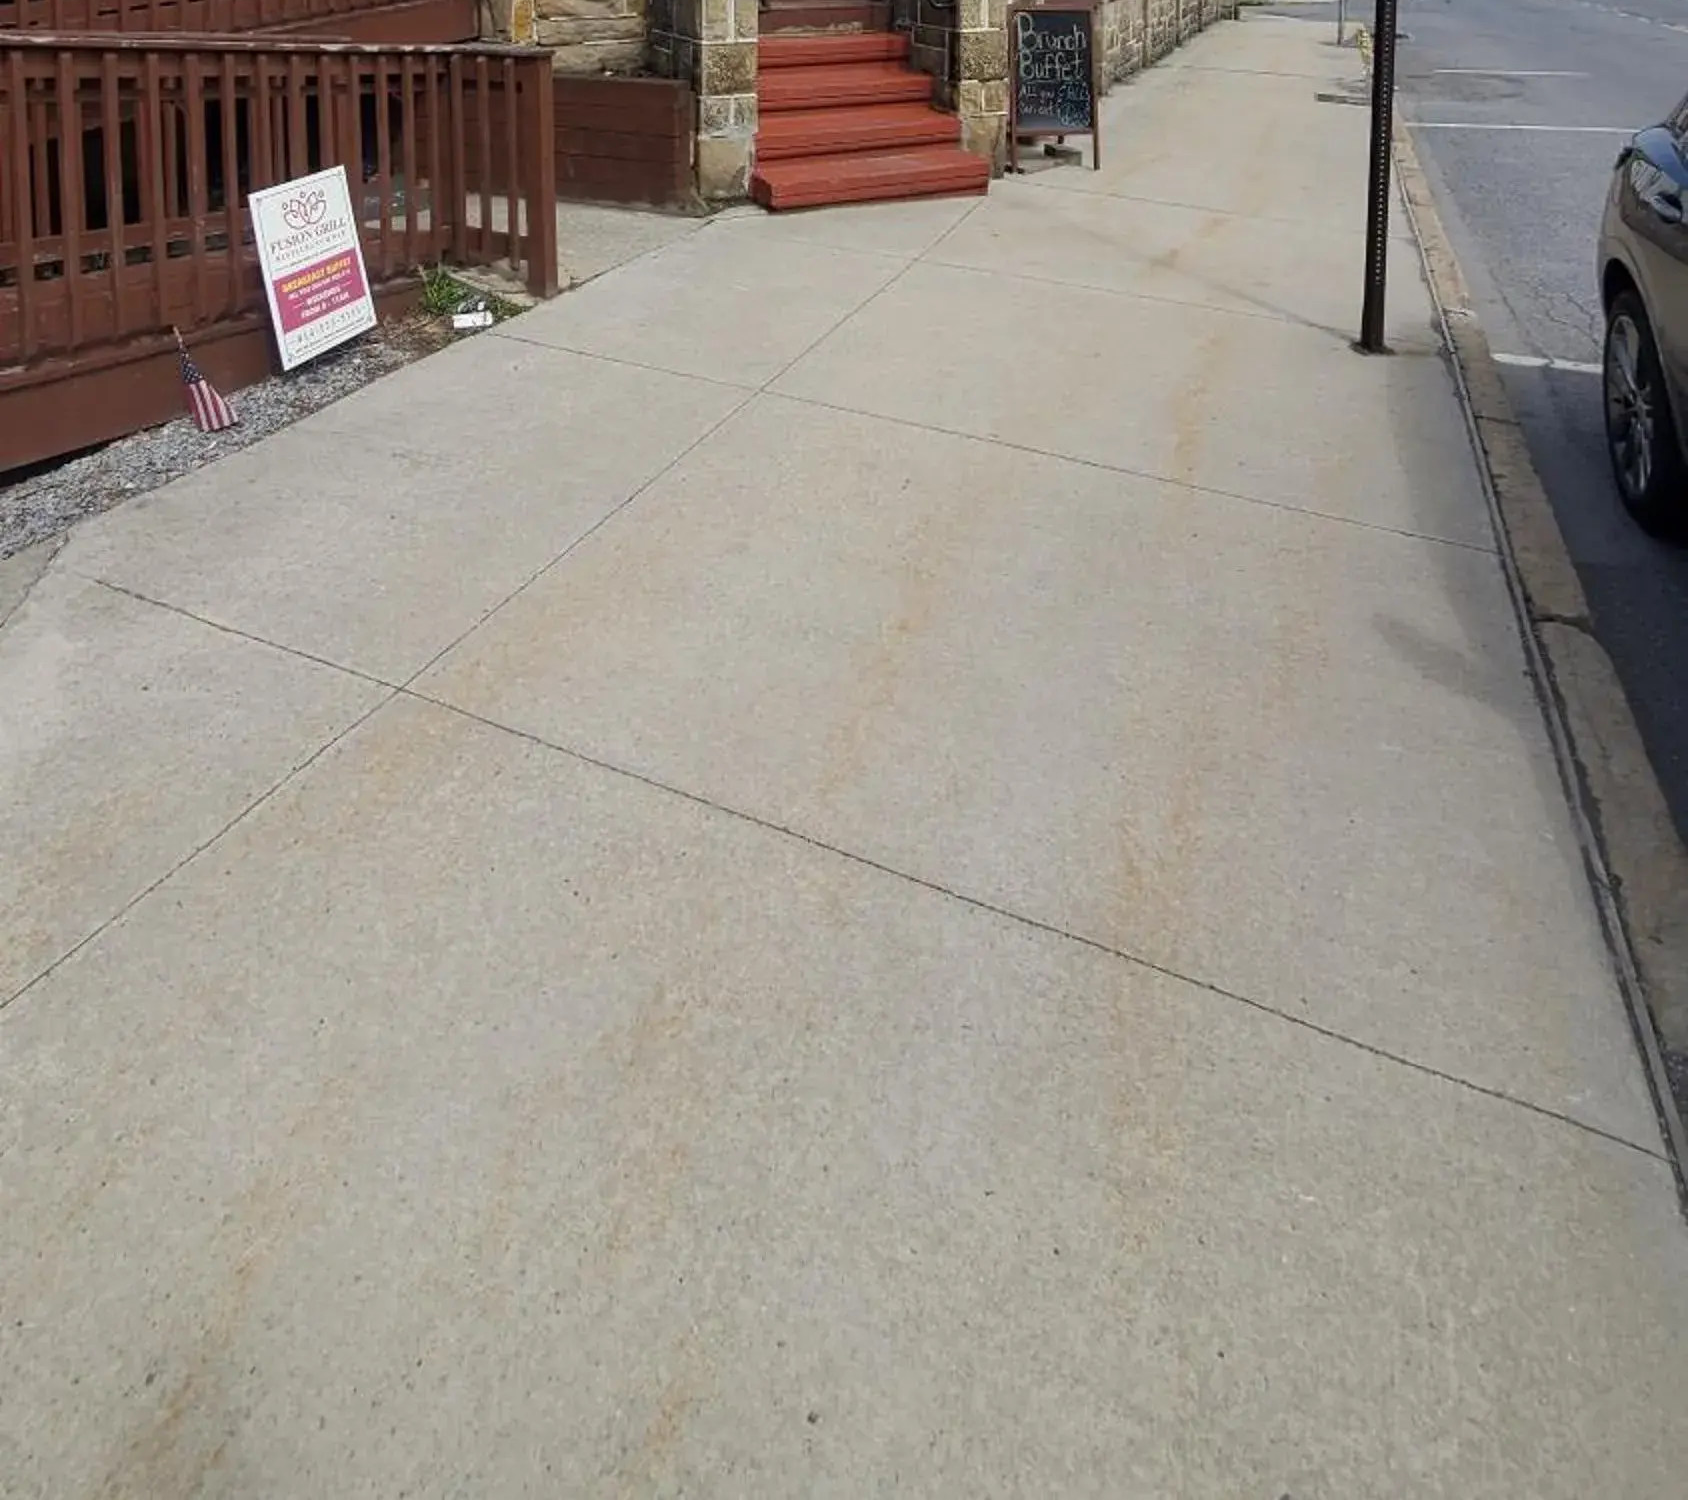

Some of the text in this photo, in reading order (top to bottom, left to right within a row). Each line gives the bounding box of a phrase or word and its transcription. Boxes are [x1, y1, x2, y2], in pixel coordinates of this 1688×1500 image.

[1014, 12, 1087, 51] Brunch
[1019, 49, 1085, 81] Buffet
[314, 216, 346, 235] GRILL
